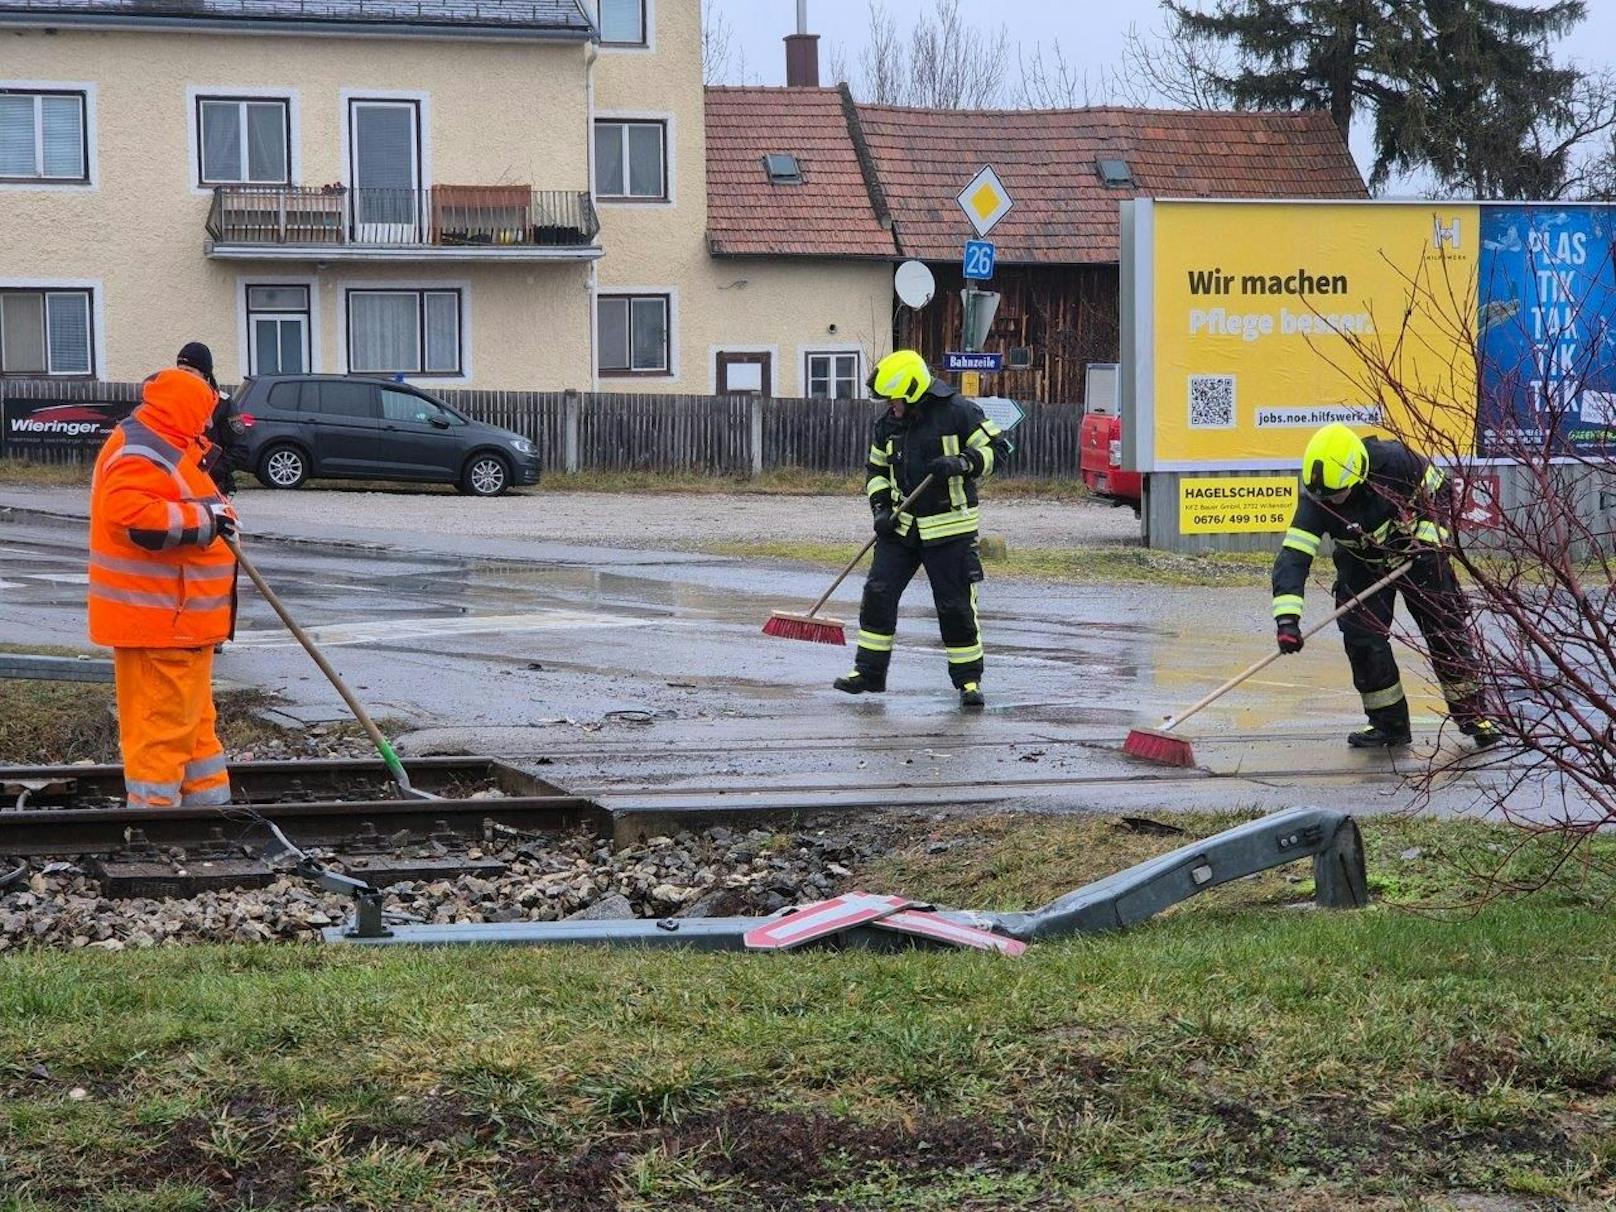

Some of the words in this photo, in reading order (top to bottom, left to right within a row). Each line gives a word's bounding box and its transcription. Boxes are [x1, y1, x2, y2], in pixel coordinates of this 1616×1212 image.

[966, 246, 992, 275] 26
[1527, 230, 1587, 265] PLAS
[1188, 268, 1234, 295] Wir
[1241, 268, 1348, 295] machen
[1536, 270, 1576, 303] TIK
[1190, 308, 1274, 341] Pflege
[1280, 307, 1376, 335] besser.
[1530, 307, 1578, 339] TAK
[950, 356, 996, 369] Bahnzeile
[1532, 343, 1577, 376] TIK
[1258, 410, 1379, 426] jobs.noe.hilfswerk.at
[1185, 487, 1292, 498] HAGELSCHADEN
[1193, 515, 1225, 525] 0676/
[1229, 514, 1250, 524] 499
[1254, 513, 1267, 523] 10
[1270, 514, 1284, 523] 56
